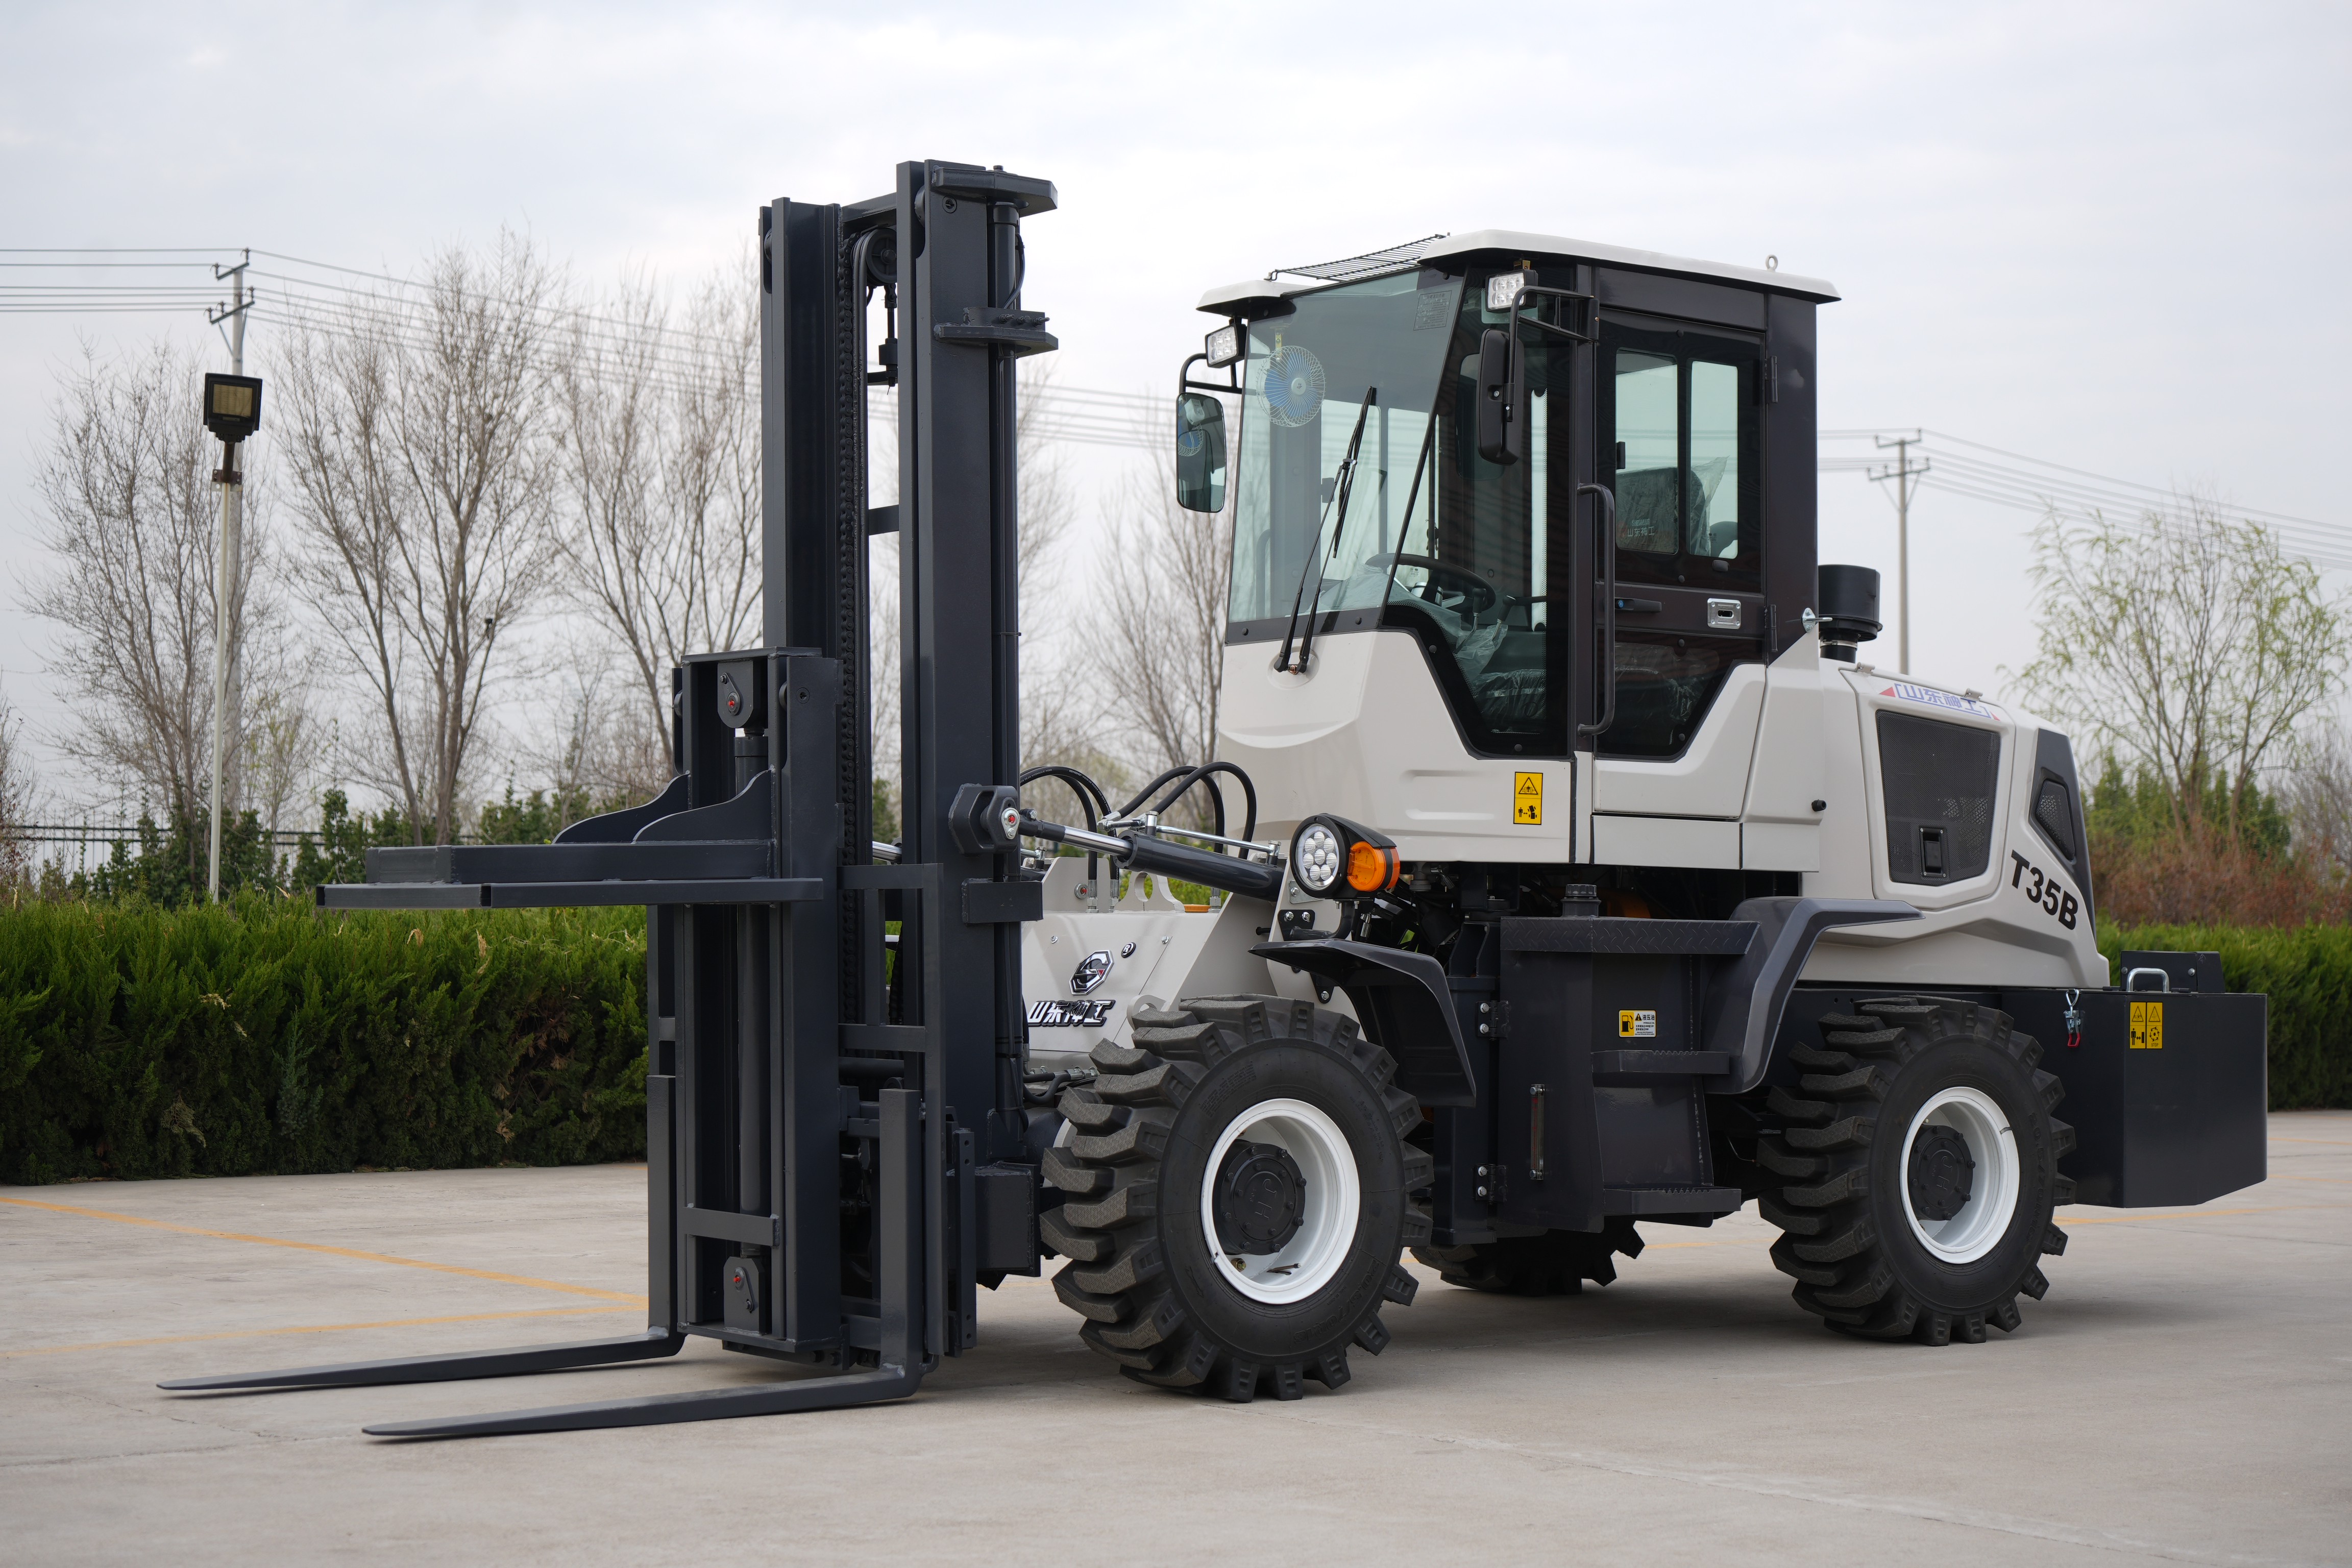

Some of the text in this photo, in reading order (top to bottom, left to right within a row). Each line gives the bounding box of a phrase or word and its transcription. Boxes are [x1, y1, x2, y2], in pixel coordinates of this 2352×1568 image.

[1904, 684, 1981, 714] 山东神工
[2011, 849, 2079, 930] T35B
[1027, 1000, 1115, 1026] 山东神工
